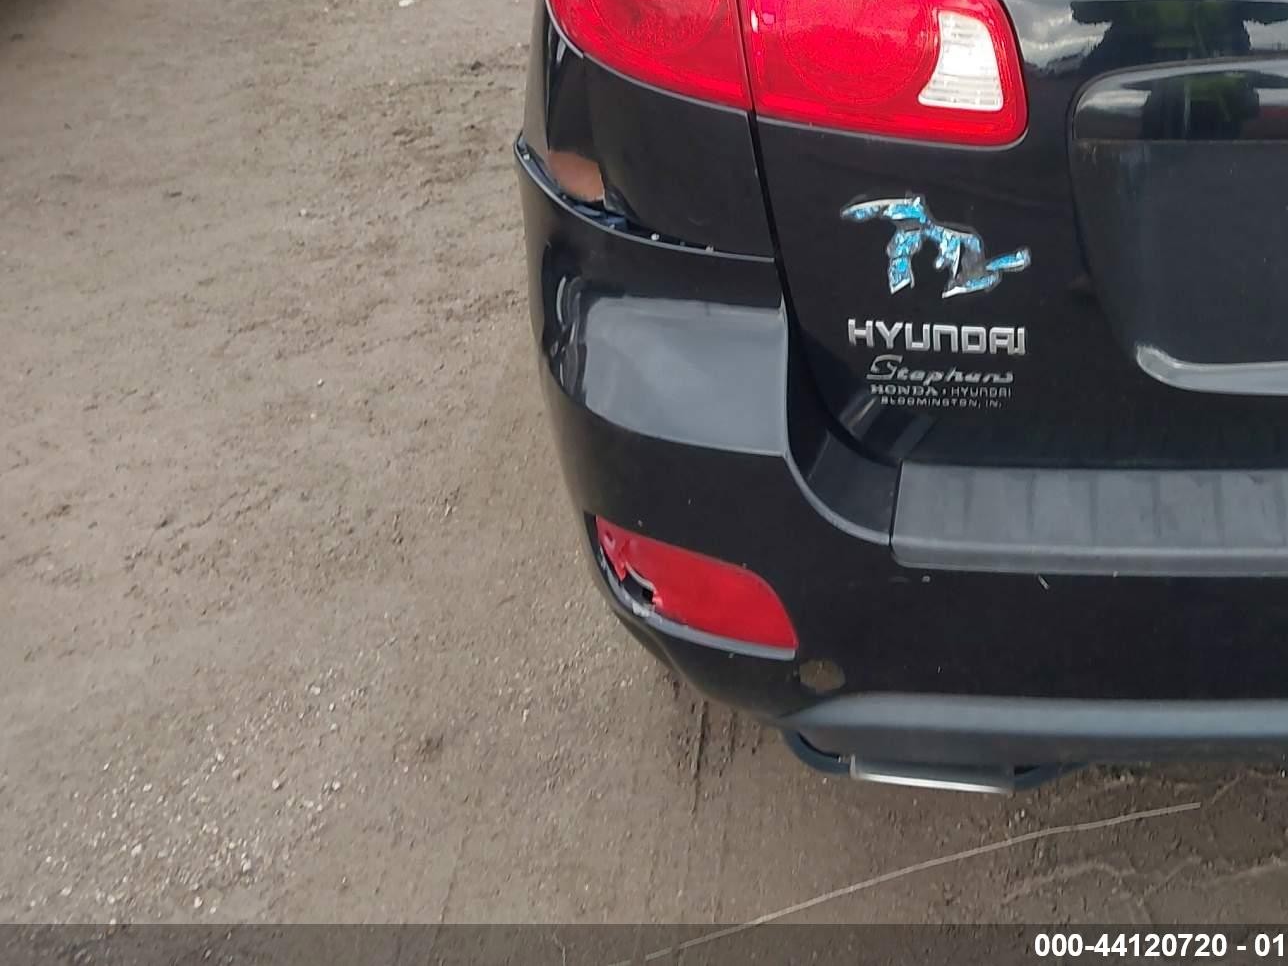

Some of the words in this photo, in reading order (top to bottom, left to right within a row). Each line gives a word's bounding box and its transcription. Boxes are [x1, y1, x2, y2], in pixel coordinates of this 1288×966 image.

[848, 318, 1026, 355] HYUNDAI
[870, 384, 938, 397] HONDA
[951, 387, 1012, 398] HYUNDAI
